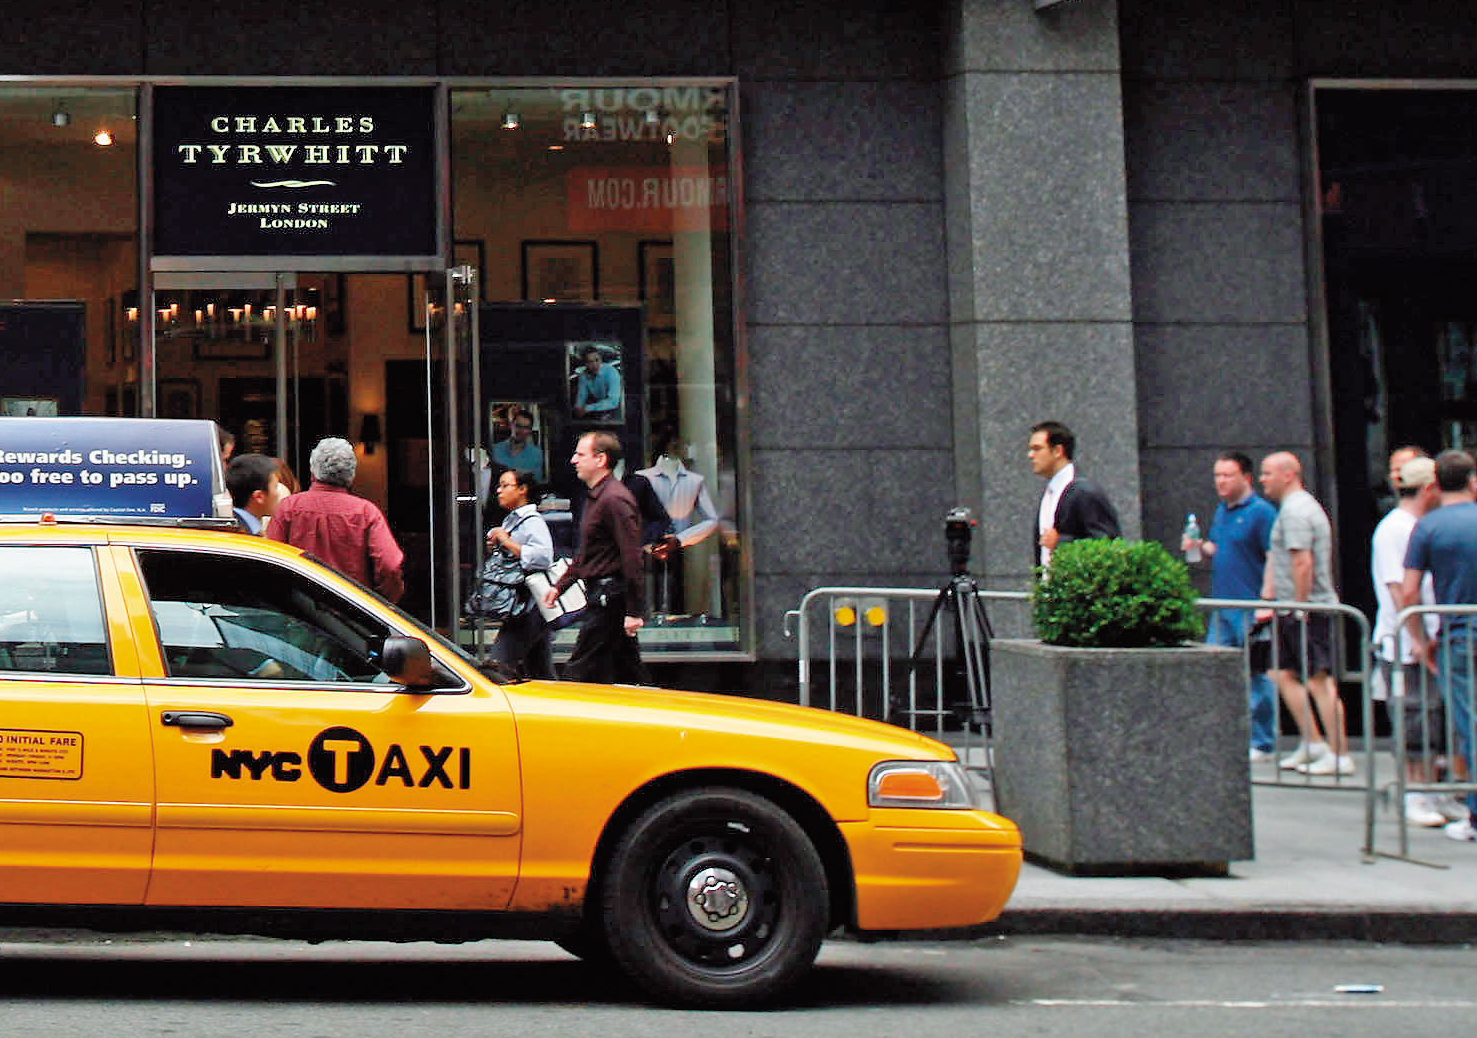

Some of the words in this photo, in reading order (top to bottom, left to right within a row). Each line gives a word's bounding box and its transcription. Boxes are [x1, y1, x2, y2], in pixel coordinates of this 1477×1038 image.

[211, 116, 374, 134] CHARLES
[178, 144, 408, 164] TYRWHITT
[228, 203, 292, 215] JERMYN
[298, 203, 361, 214] STREET
[260, 218, 328, 229] LONDON
[89, 449, 193, 469] Checking.
[30, 468, 74, 484] free
[80, 470, 104, 484] to
[110, 472, 158, 488] pass
[164, 472, 199, 488] up.
[6, 736, 45, 745] INITIAL
[50, 738, 77, 747] FARE
[210, 748, 303, 782] NYC
